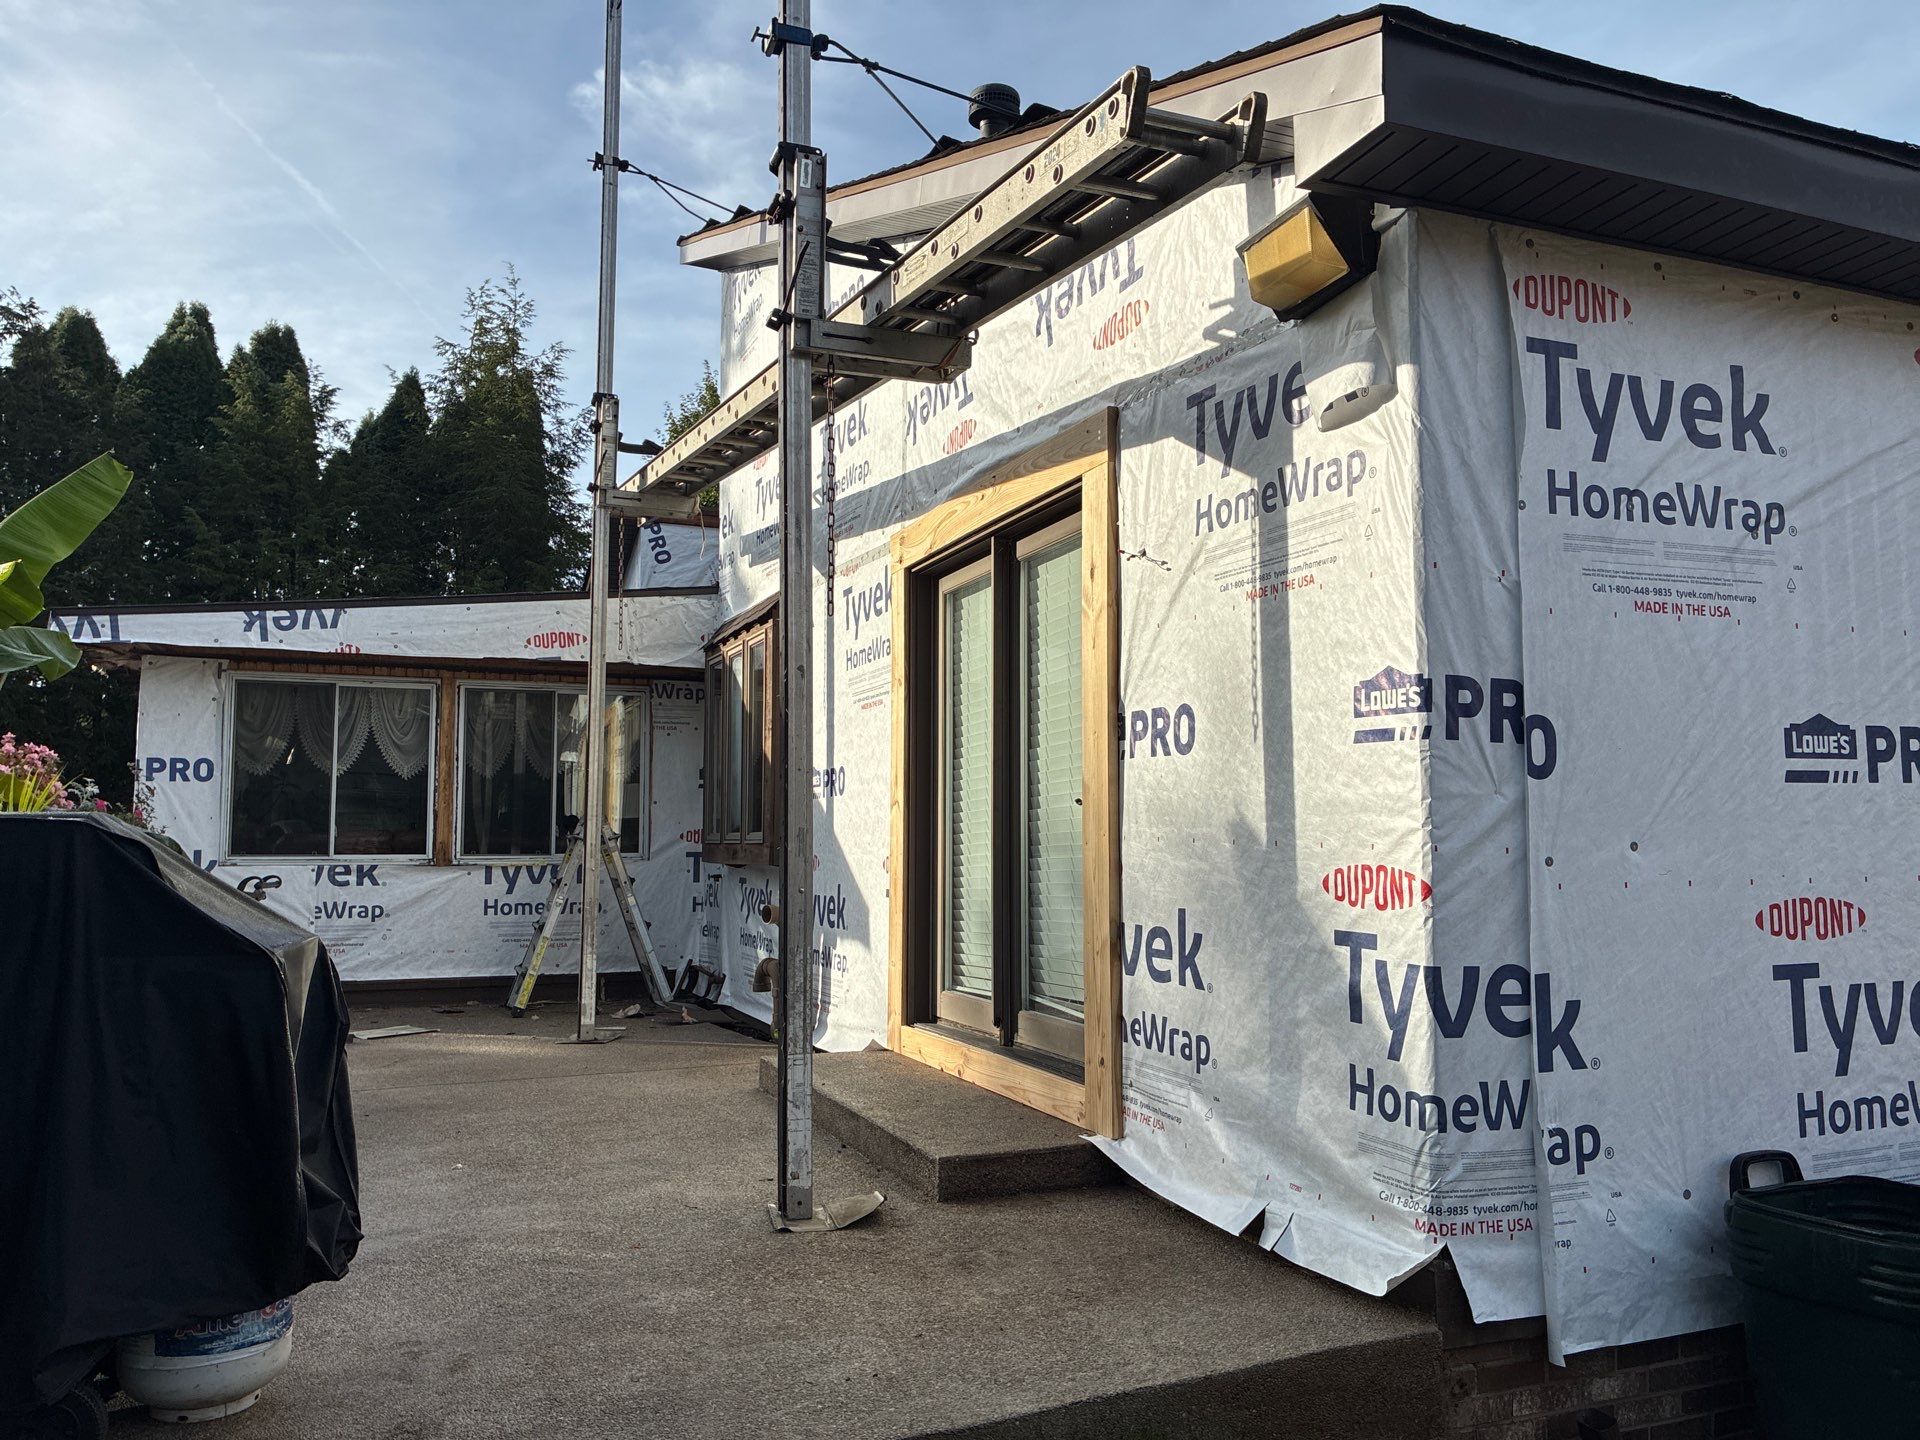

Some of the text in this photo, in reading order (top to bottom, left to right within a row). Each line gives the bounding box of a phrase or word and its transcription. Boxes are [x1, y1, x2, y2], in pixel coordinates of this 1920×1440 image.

[1524, 274, 1619, 324] DUPONT
[1097, 300, 1141, 350] DUPONT
[1186, 360, 1314, 479] Tyve
[1526, 336, 1776, 462] Tyvek
[756, 473, 779, 521] Tyve
[1195, 449, 1366, 537] HomeWrap
[1547, 469, 1786, 545] HomeWrap
[644, 520, 671, 564] PRO
[1246, 574, 1315, 602] MADE IN THE USA
[1592, 582, 1757, 604] Call 1-800-448-9835 tyvek.com/homewrap
[1634, 600, 1731, 618] MADE IN THE USA
[533, 632, 581, 649] DUPONT
[846, 636, 891, 671] HomeWra
[1360, 684, 1424, 712] LOWE'S
[1129, 703, 1196, 759] PRO
[1792, 725, 1920, 784] LOWE'S PR
[145, 757, 215, 782] PRO
[823, 766, 845, 798] PRO
[315, 901, 384, 922] eWrap
[1333, 863, 1417, 912] DUPONT
[1769, 897, 1854, 941] DUPONT
[1122, 908, 1205, 992] vek
[1122, 1010, 1210, 1075] eWrap
[1772, 962, 1920, 1077] Tyv
[1796, 1081, 1920, 1139] Home
[1378, 1190, 1396, 1204] Call
[1397, 1196, 1469, 1216] 1-800-448-9835
[1415, 1218, 1533, 1237] MADE IN THE USA
